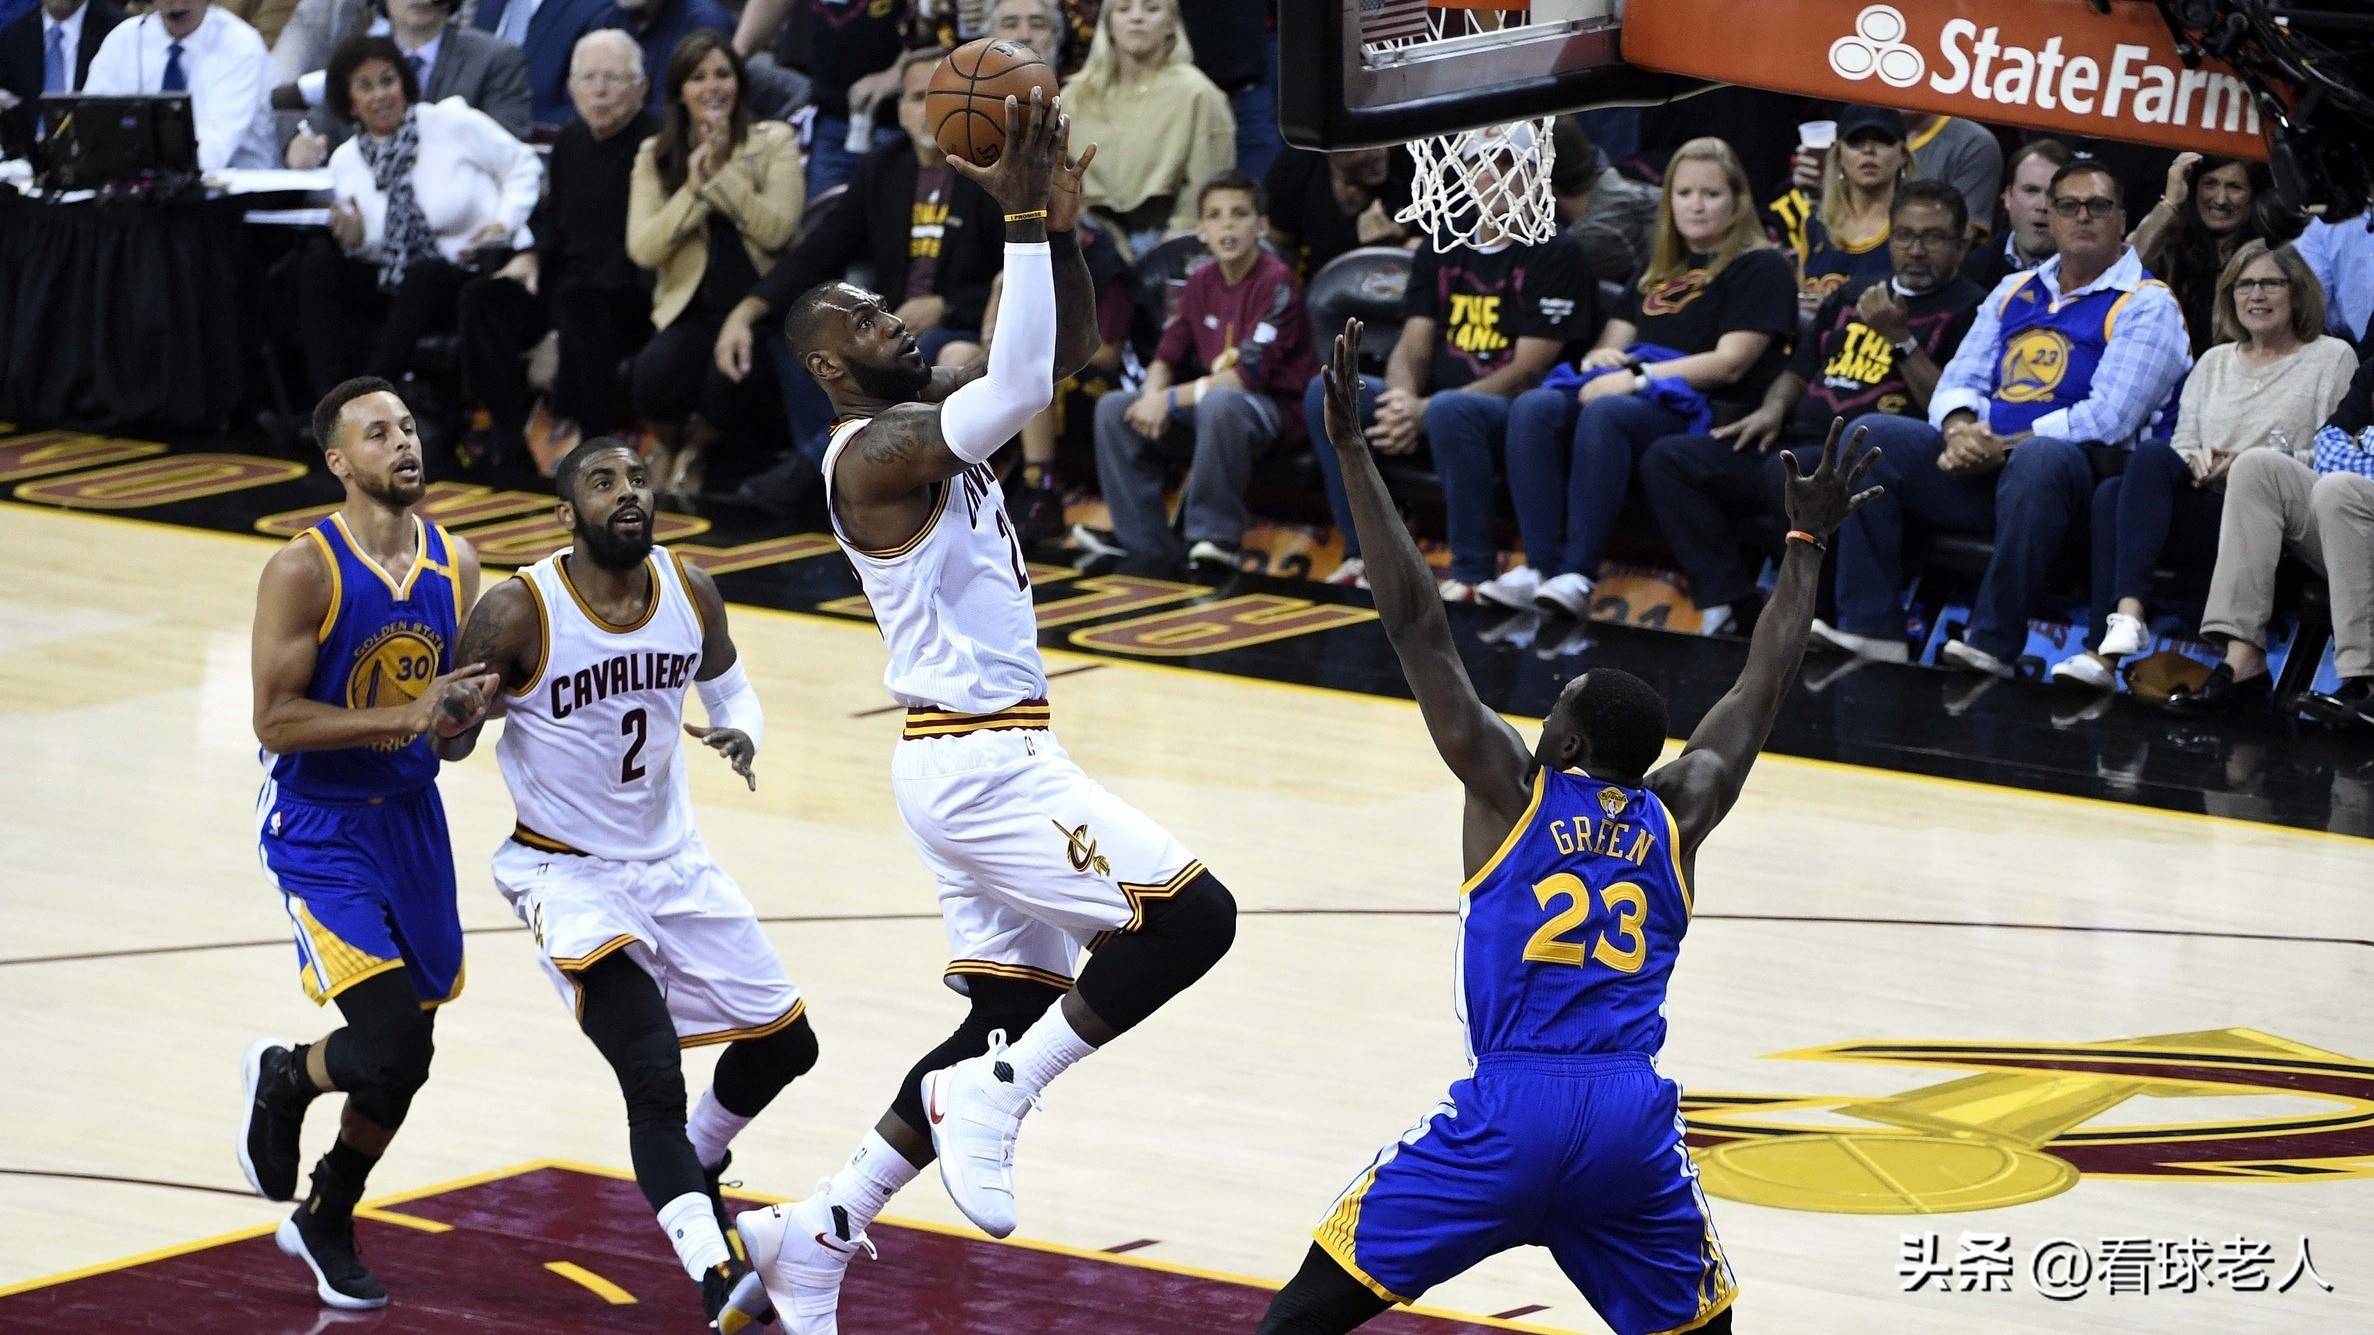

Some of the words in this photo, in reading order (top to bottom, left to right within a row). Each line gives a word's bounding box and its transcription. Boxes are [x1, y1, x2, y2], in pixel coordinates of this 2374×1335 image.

[354, 620, 407, 657] GOLDEN
[396, 655, 430, 682] 30
[551, 652, 698, 719] CAVALIERS
[621, 707, 647, 784] 2
[1550, 816, 1656, 867] GREEN
[1522, 872, 1648, 974] 23
